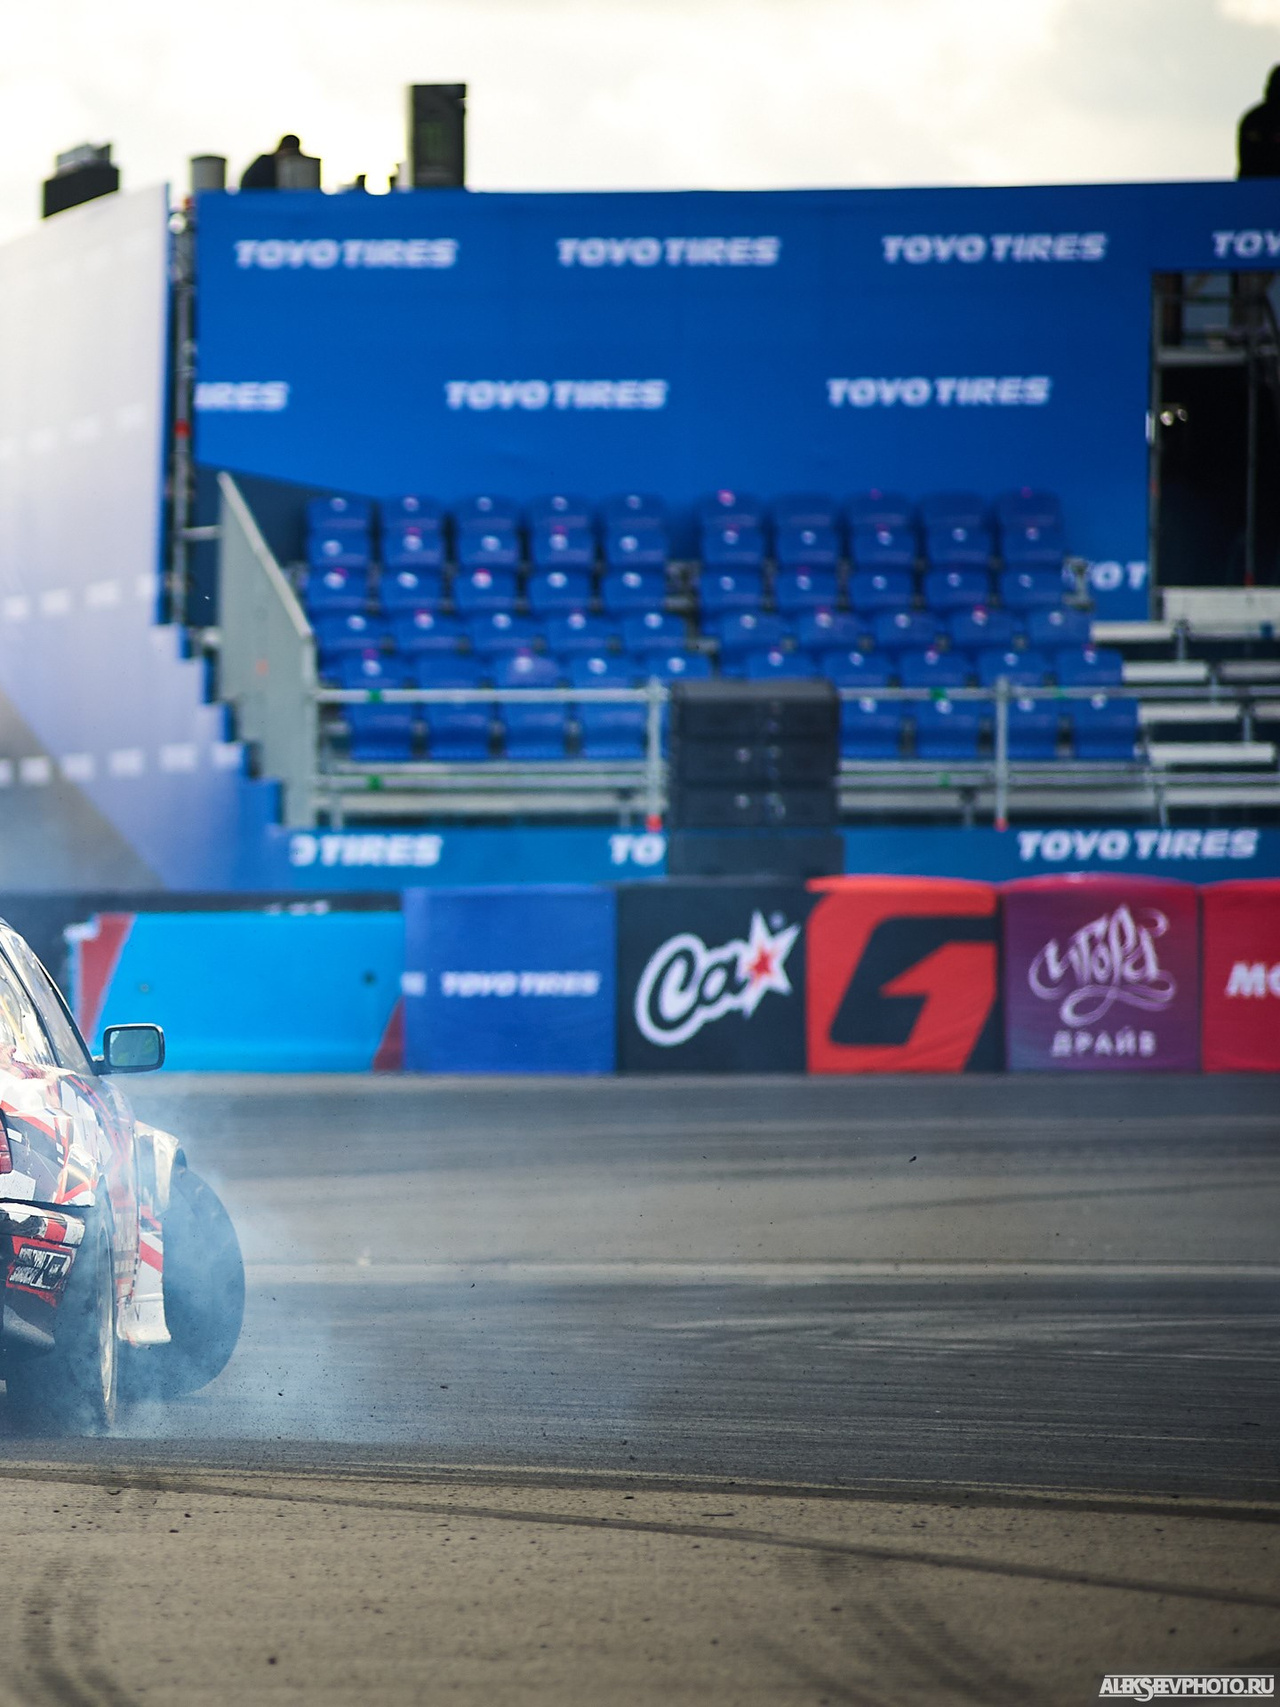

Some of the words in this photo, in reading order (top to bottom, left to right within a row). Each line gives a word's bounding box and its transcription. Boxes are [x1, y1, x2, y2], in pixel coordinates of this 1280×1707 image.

[236, 239, 340, 269] TOYO
[342, 239, 458, 269] TIRES
[558, 238, 662, 267] TOYO
[664, 237, 780, 266] TIRES
[882, 234, 987, 263] TOYO
[991, 233, 1108, 262] TIRES
[446, 381, 551, 409] TOYO
[553, 380, 668, 409] TIRES
[827, 378, 931, 407] TOYO
[934, 377, 1051, 405] TIRES
[321, 834, 444, 866] TIRES
[1018, 829, 1130, 861] TOYO
[1134, 828, 1260, 860] TIRES
[441, 971, 518, 998] TOYO
